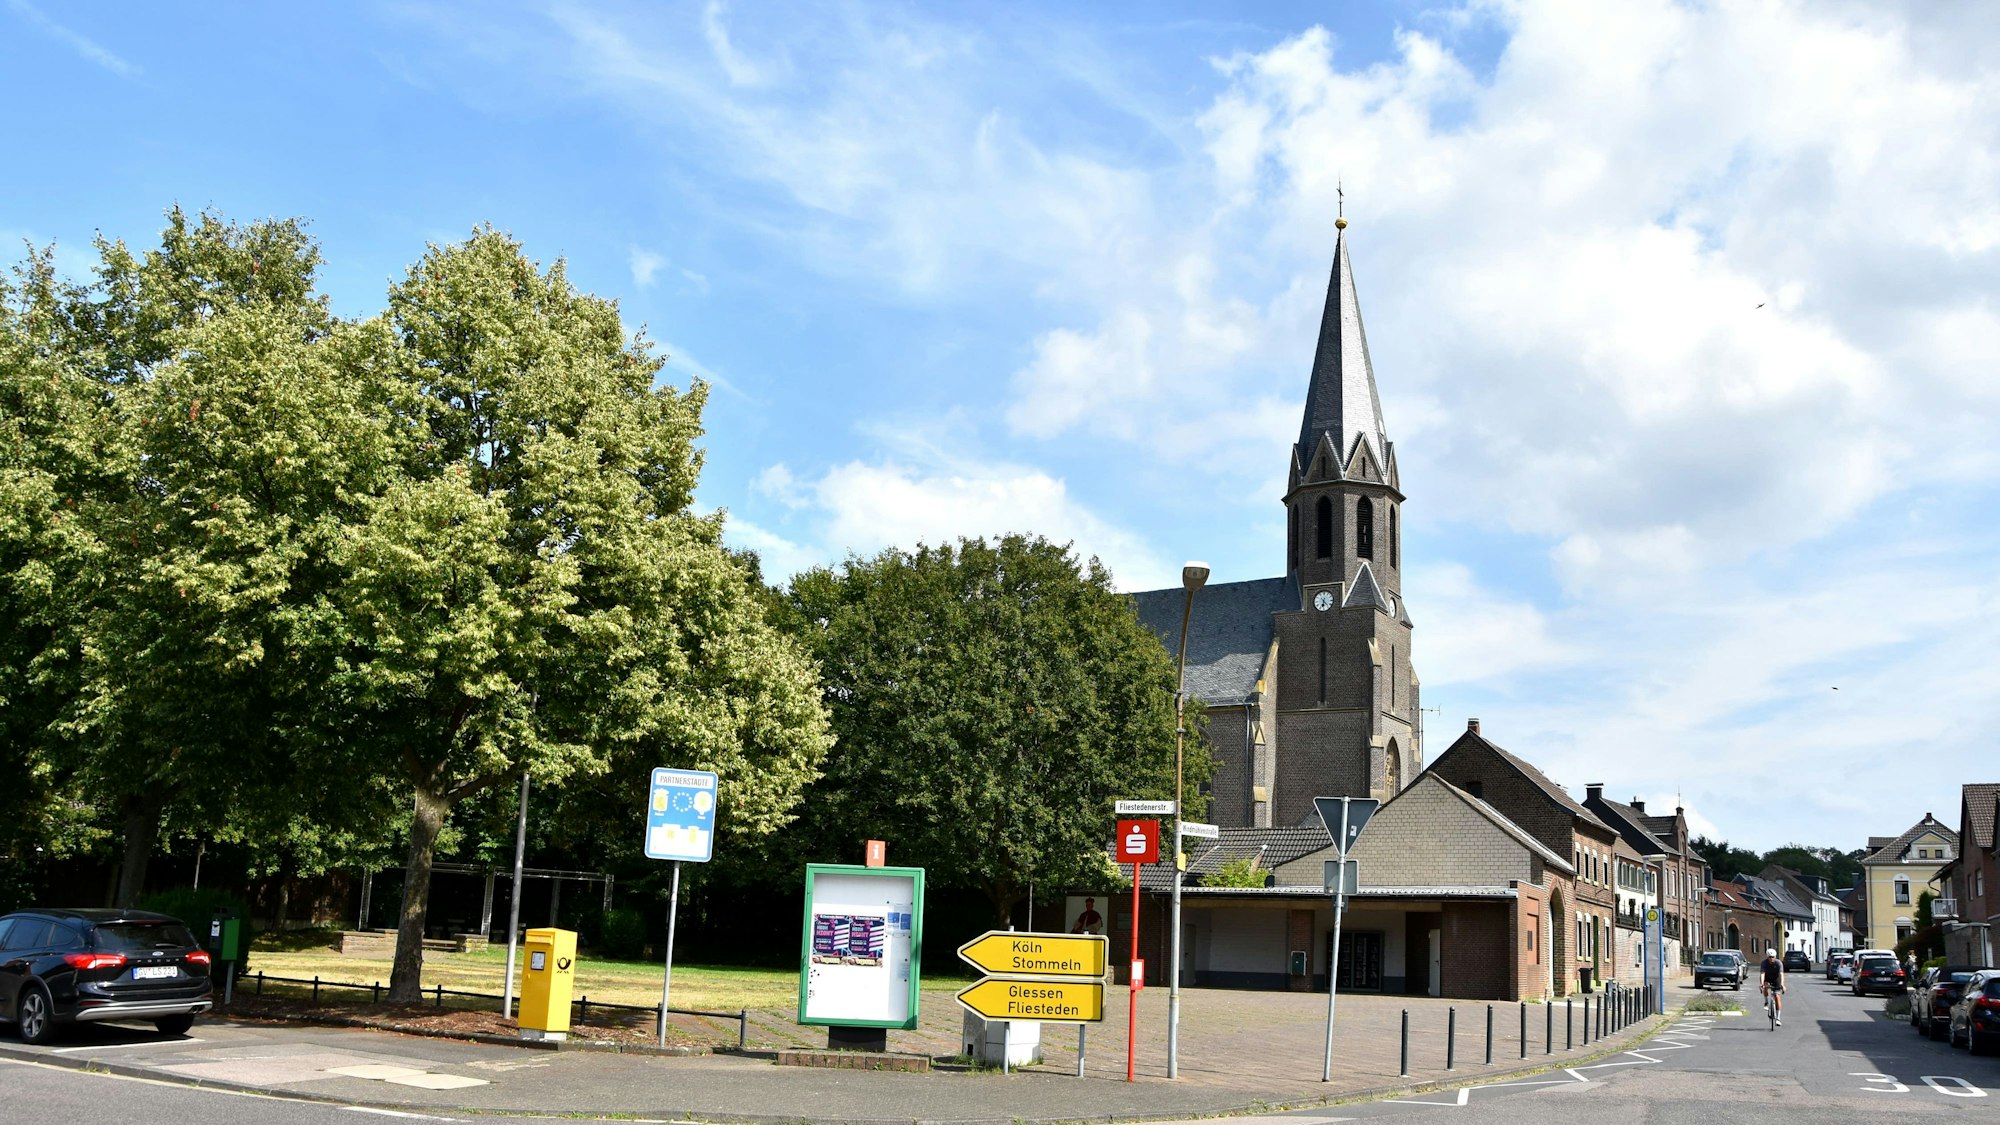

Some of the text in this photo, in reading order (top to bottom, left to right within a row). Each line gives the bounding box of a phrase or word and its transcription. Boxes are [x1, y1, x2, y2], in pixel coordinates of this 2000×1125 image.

[1119, 802, 1169, 811] Fliestedenerstr.
[1012, 940, 1042, 953] Köln
[1012, 956, 1081, 971] Stommeln
[1008, 985, 1063, 999] Glessen
[1008, 1001, 1079, 1015] Fliesteden
[1847, 1072, 1988, 1098] 30
